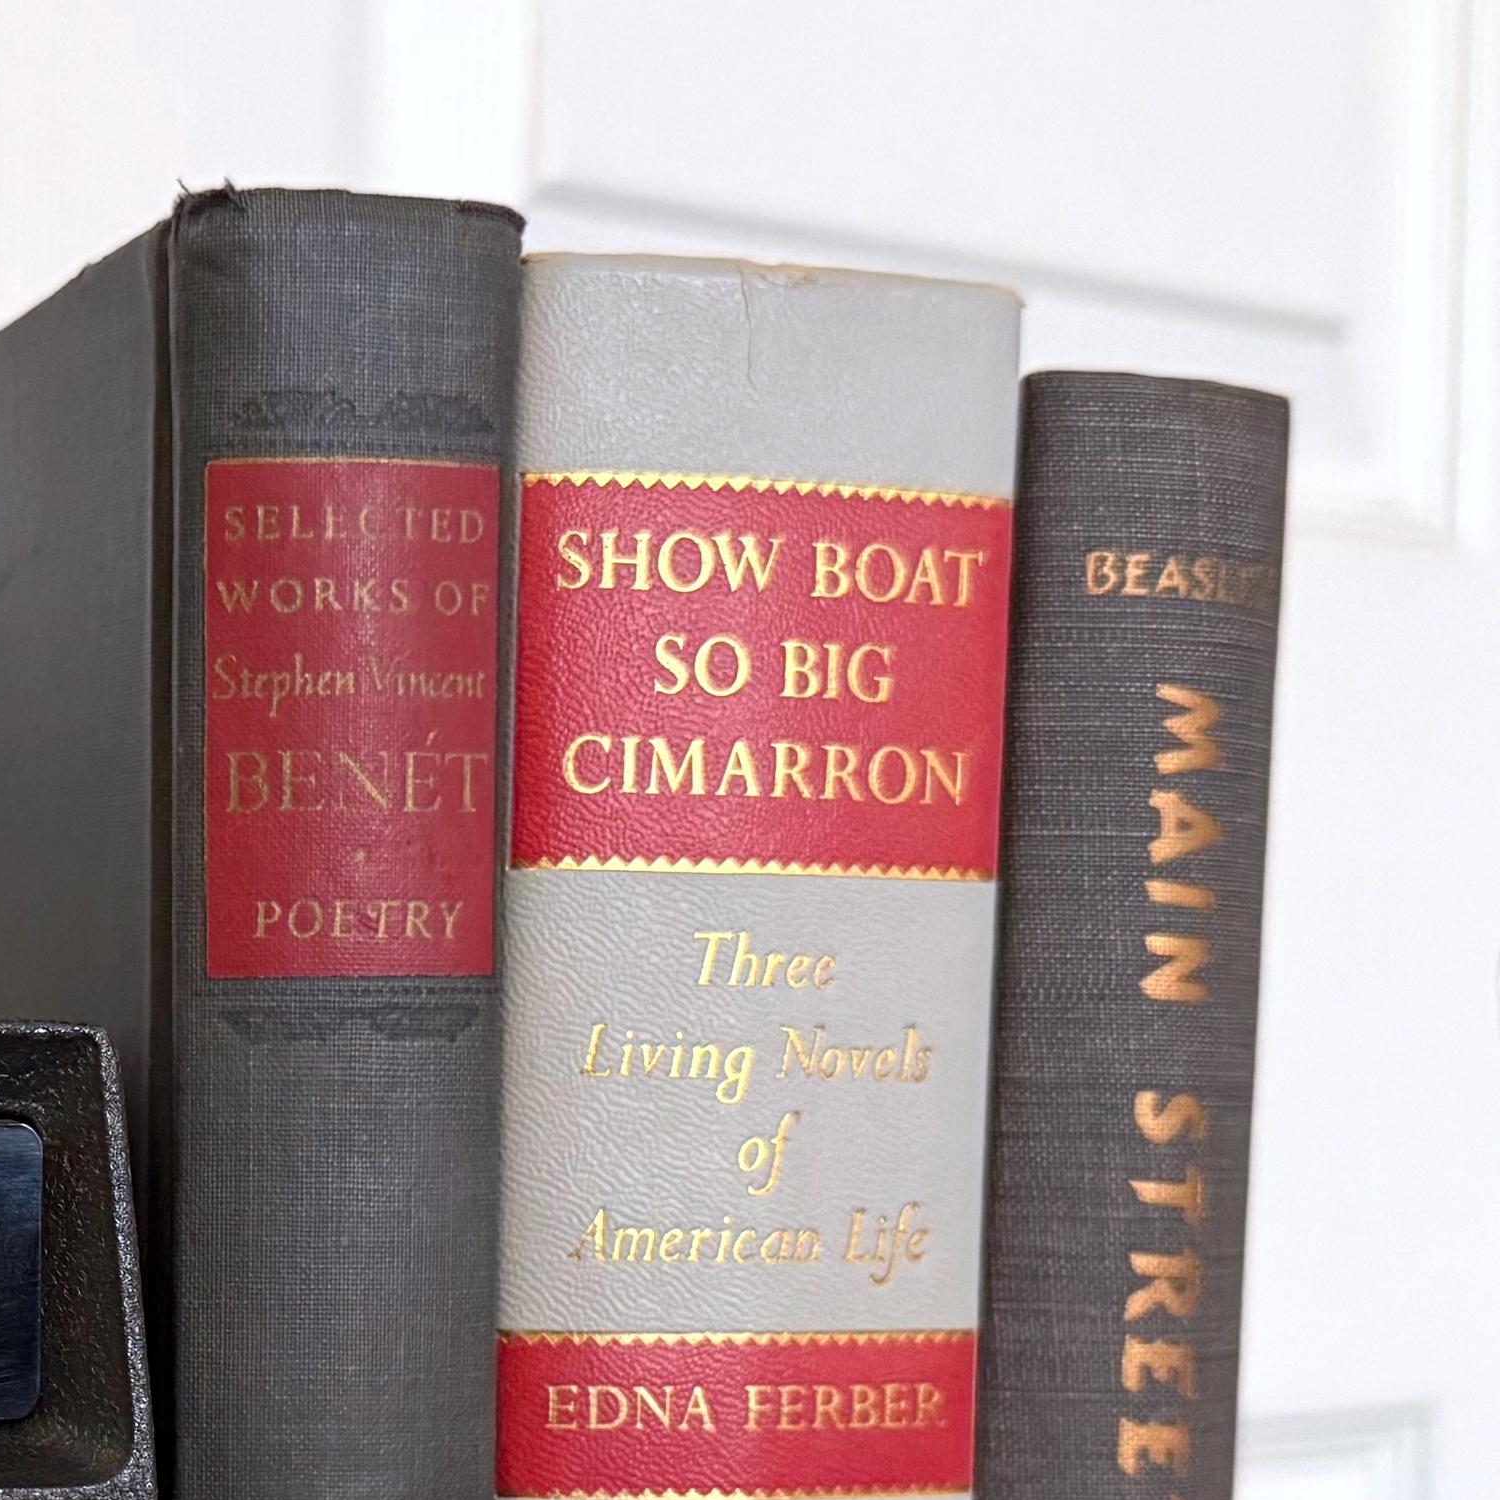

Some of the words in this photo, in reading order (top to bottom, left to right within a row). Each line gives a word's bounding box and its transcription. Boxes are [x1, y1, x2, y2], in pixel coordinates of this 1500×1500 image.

[223, 504, 486, 544] SELECTED
[216, 576, 411, 615] WORKS
[434, 580, 492, 617] OF
[556, 529, 784, 593] SHOW
[810, 539, 984, 608] BOAT
[213, 652, 356, 719] Stephen
[368, 655, 486, 700] Vincent
[653, 633, 750, 698] SO
[780, 639, 896, 704] BIG
[225, 729, 488, 814] BENÉT
[562, 734, 968, 807] CIMARRON
[1138, 682, 1227, 1004] MAIN
[252, 900, 465, 940] POETRY
[692, 929, 837, 990] Three
[579, 1022, 755, 1105] Living
[776, 1023, 934, 1085] Novels
[736, 1110, 800, 1197] of
[567, 1206, 823, 1266] American
[842, 1200, 931, 1287] Life
[545, 1383, 717, 1434] EDNA
[744, 1380, 947, 1434] FERBER
